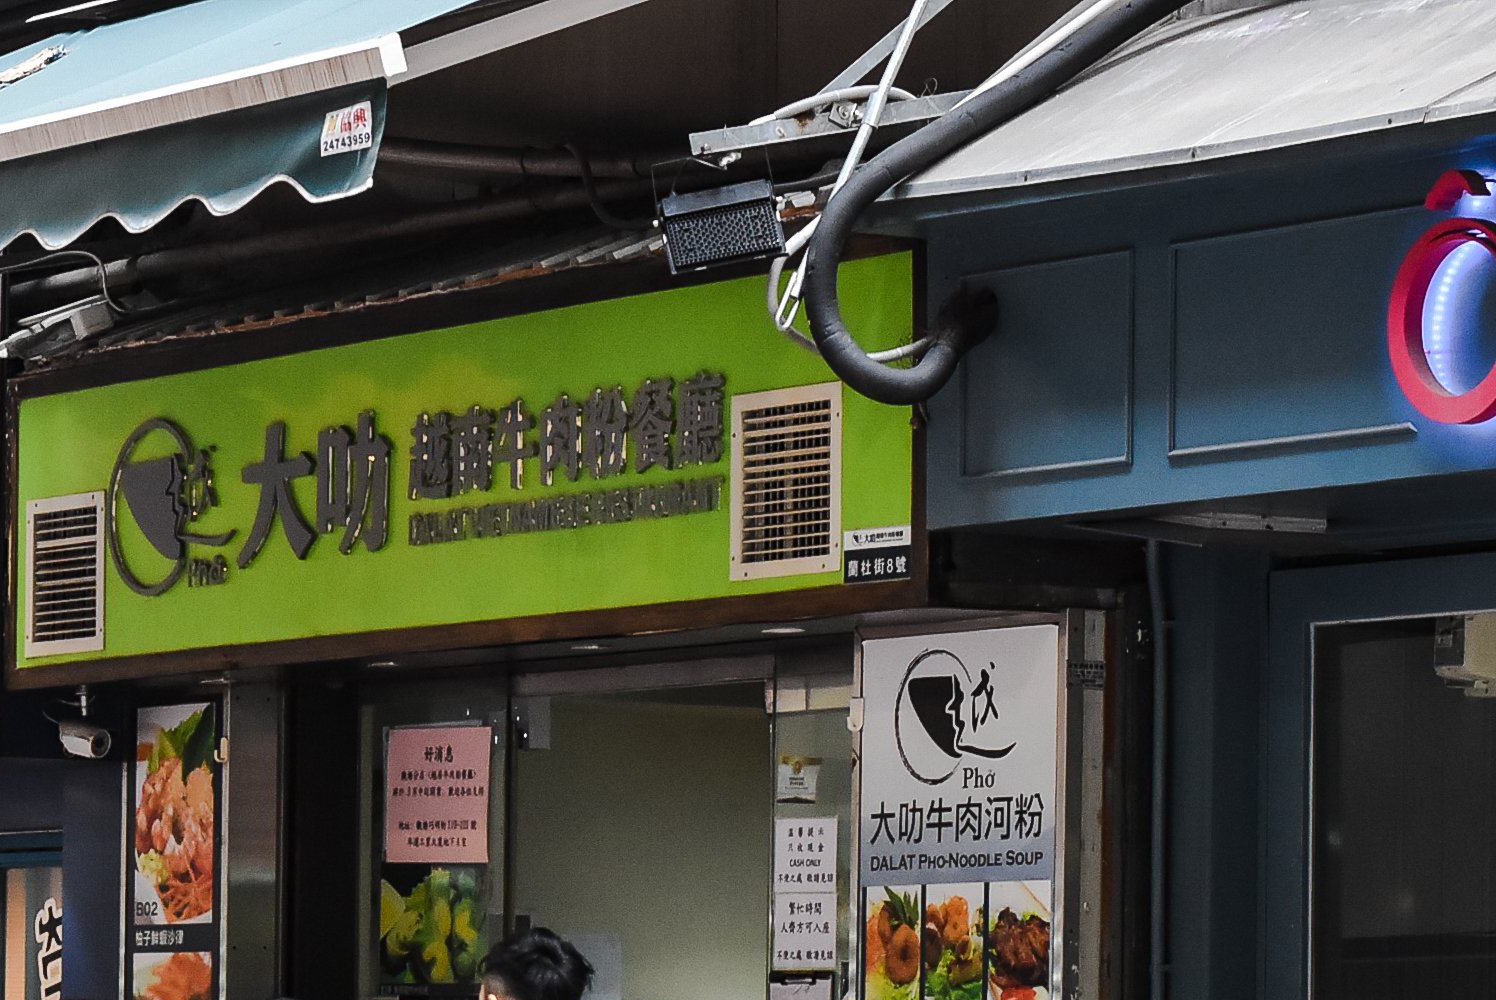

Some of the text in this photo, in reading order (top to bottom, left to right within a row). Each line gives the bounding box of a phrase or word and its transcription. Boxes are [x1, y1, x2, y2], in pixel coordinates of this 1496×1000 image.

[323, 132, 371, 152] 24743959
[237, 408, 393, 569] 大叻
[869, 792, 1044, 845] 大叻牛肉河粉
[870, 854, 916, 871] DALAT
[1005, 850, 1044, 866] SOUP
[136, 901, 159, 917] B02
